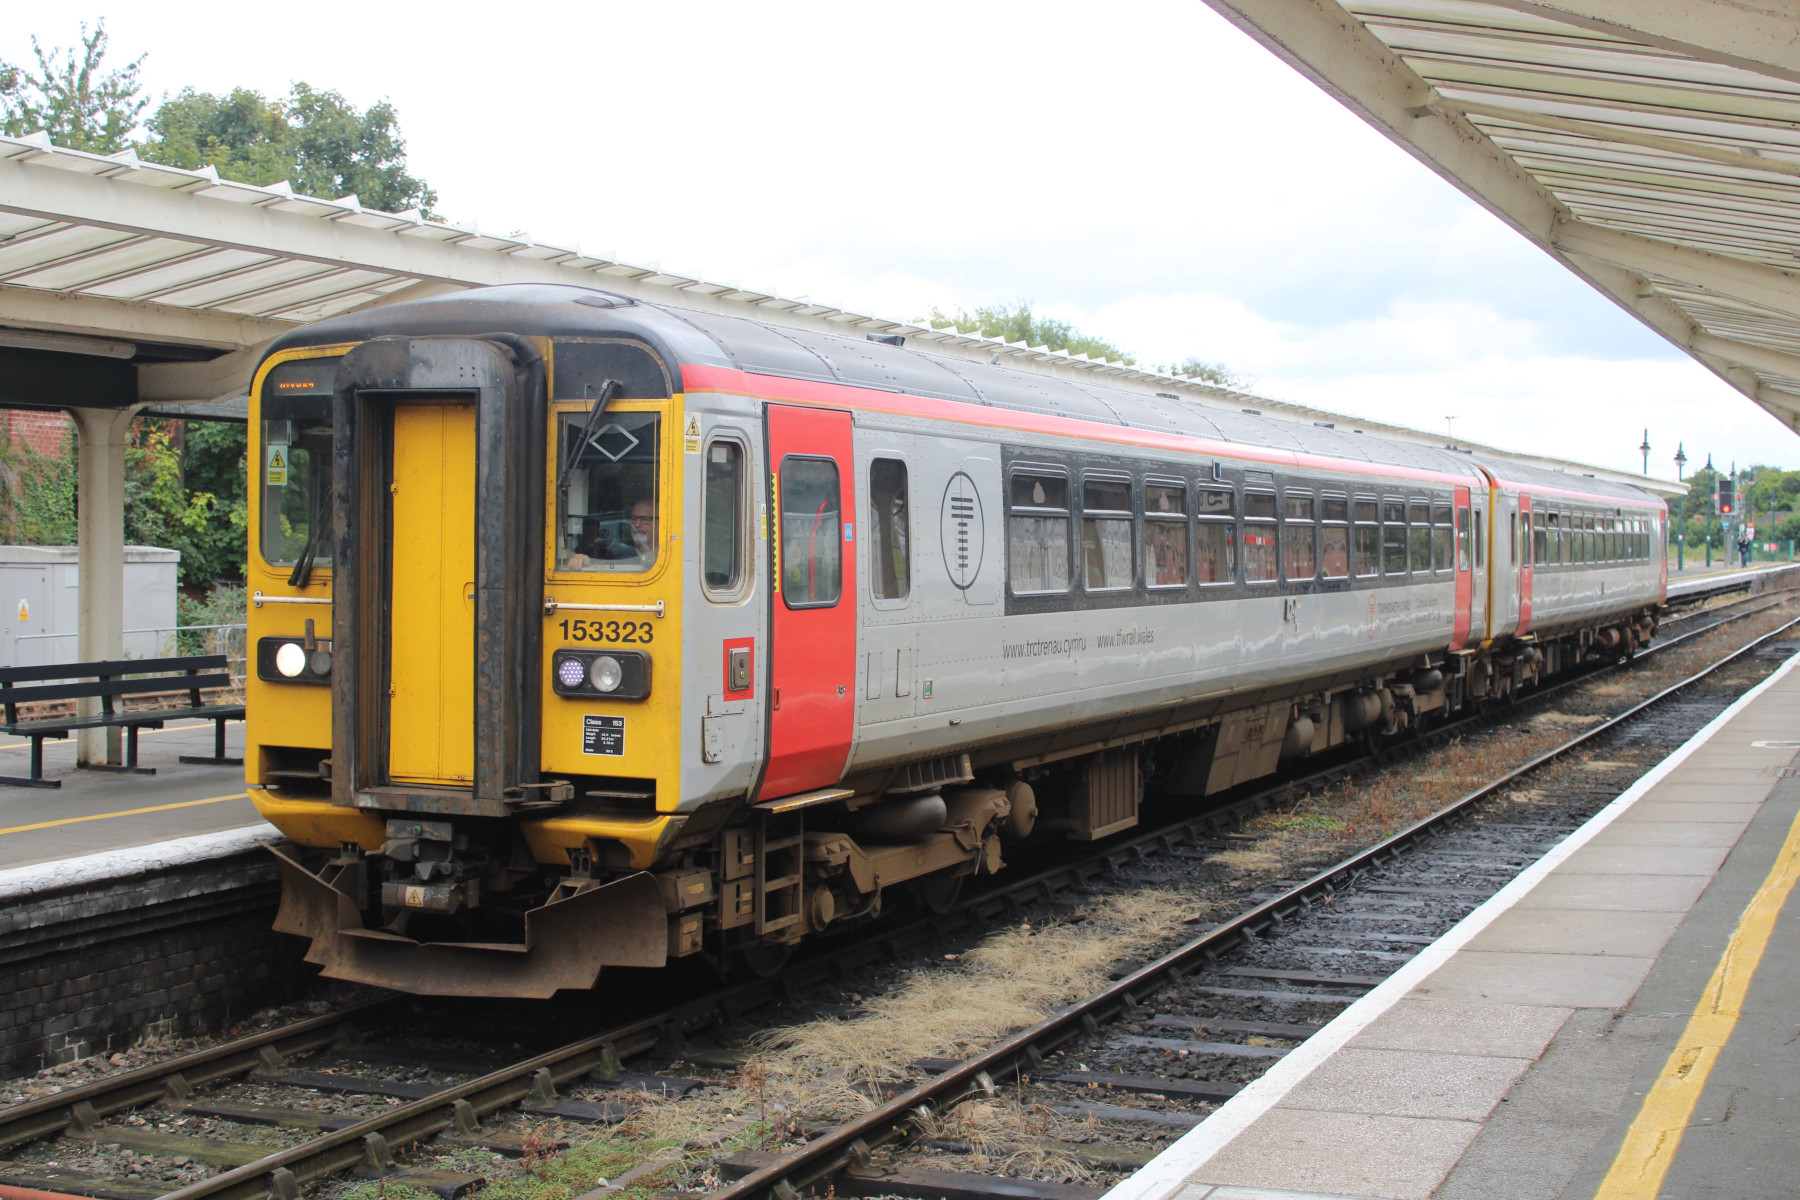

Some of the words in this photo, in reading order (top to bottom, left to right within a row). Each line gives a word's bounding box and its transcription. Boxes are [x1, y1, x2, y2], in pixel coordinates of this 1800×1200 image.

[559, 619, 653, 644] 153323
[1002, 636, 1087, 659] www.trctrenau.cymru
[1097, 626, 1155, 649] www.tfwrail.wales
